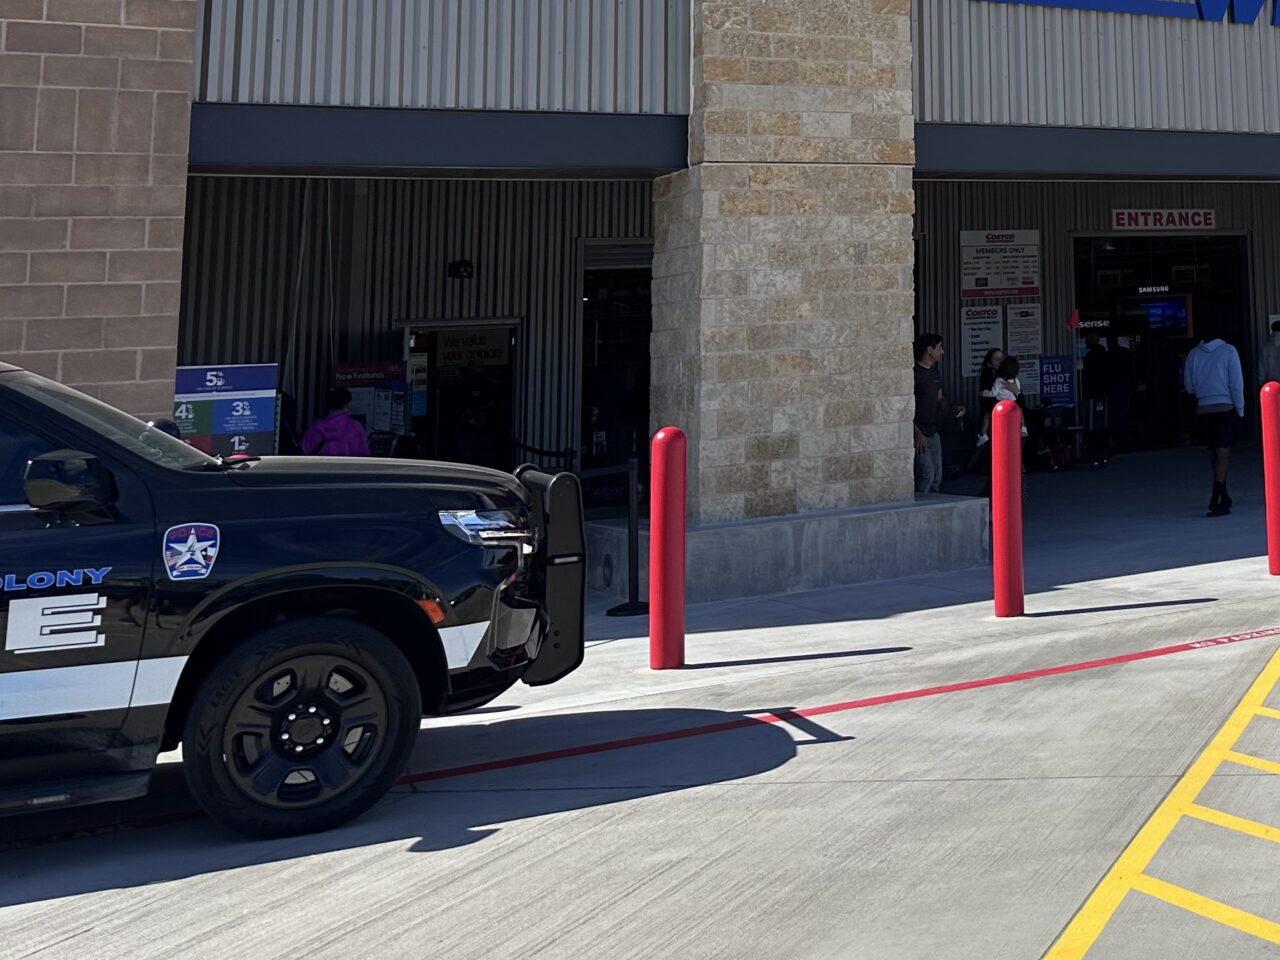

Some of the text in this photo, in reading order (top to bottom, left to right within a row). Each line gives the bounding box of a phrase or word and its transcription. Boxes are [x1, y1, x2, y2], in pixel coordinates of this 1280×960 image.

[1115, 211, 1213, 227] ENTRANCE
[1138, 285, 1169, 293] SAMSUNG
[965, 309, 998, 317] COSTCO
[1078, 319, 1111, 328] sense
[444, 334, 487, 348] We value
[443, 346, 504, 364] your opinion!
[1043, 363, 1062, 373] FLU
[335, 371, 385, 381] New Features
[1043, 373, 1071, 384] SHOT
[1043, 383, 1070, 393] HERE
[0, 566, 113, 591] LONY
